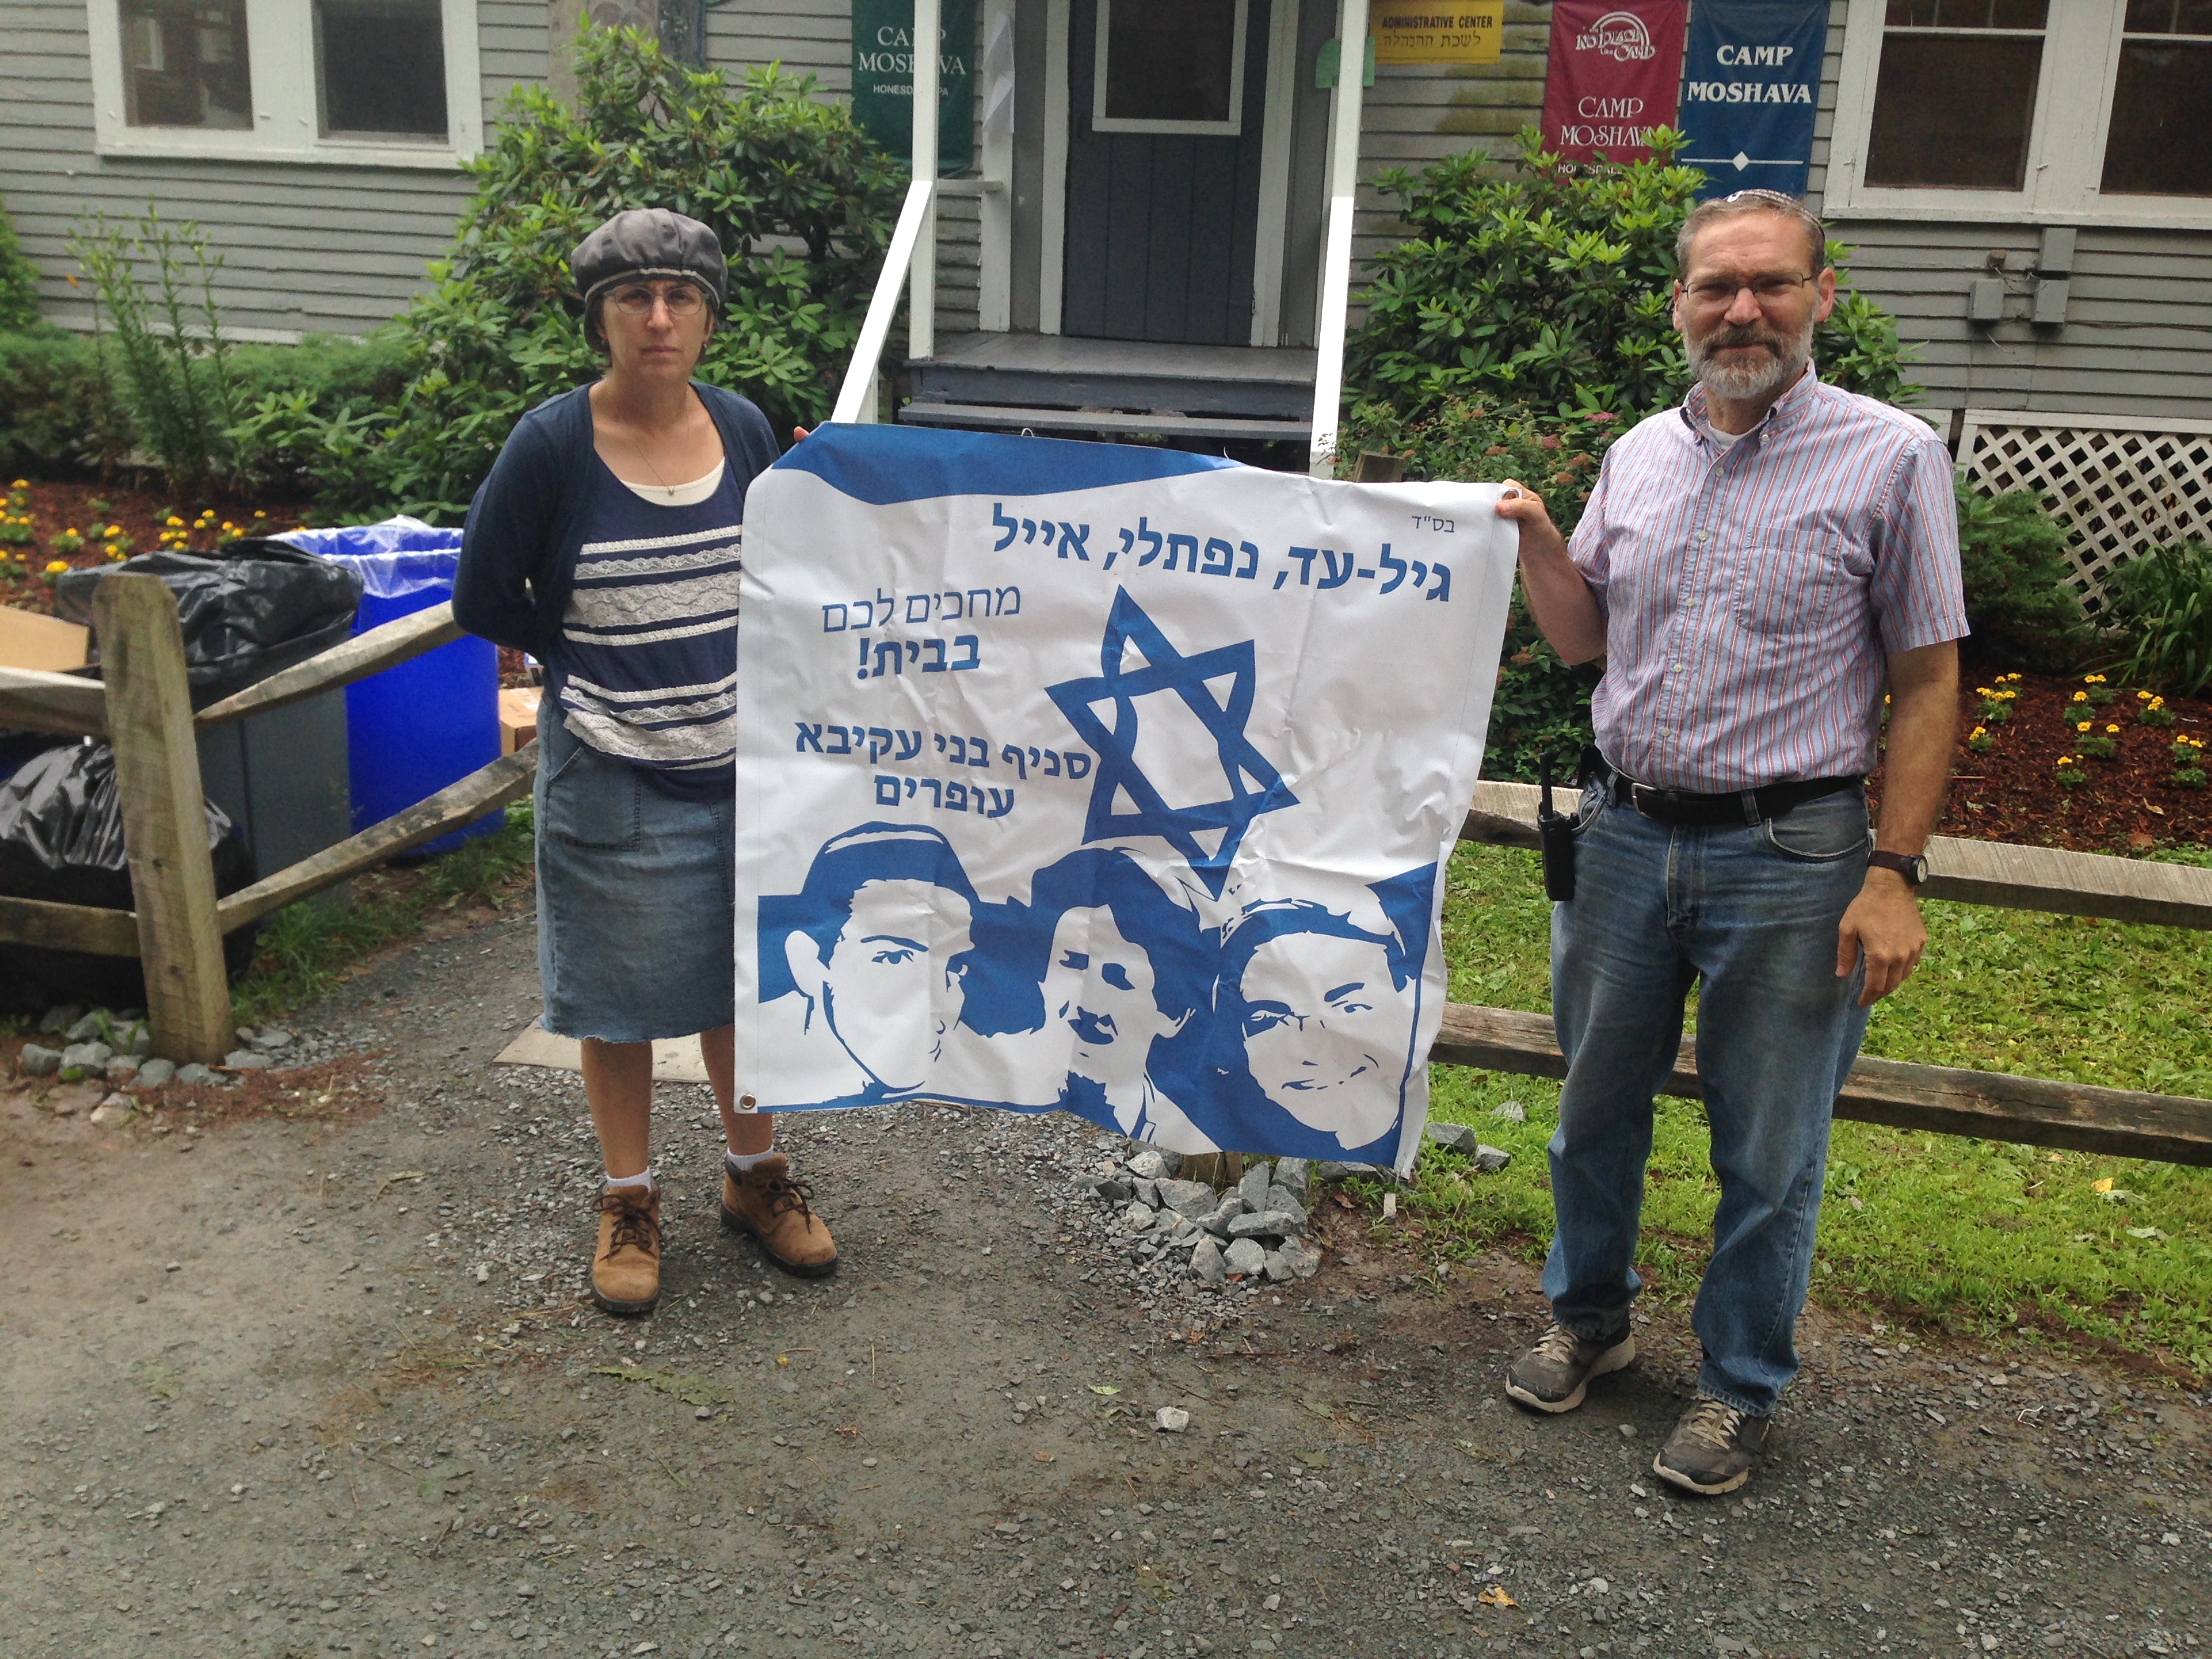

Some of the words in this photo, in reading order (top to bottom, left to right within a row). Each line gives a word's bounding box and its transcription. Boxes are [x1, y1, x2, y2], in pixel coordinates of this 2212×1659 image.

[877, 26, 947, 47] CAP
[1382, 16, 1454, 29] ADMINISTRATIVE
[1458, 16, 1493, 29] CENTER
[1440, 30, 1481, 47] לשכת
[858, 52, 966, 75] MOSVA
[1716, 45, 1794, 66] CAMP
[1578, 96, 1644, 119] CAMP
[1687, 81, 1812, 104] MOSHAVA
[992, 502, 1090, 561] אייל
[1412, 516, 1455, 533] בס"ד
[1102, 516, 1259, 579] נפתלי,
[1272, 543, 1451, 602] גיל-עד,
[822, 588, 895, 633] לכם
[905, 586, 1021, 623] מחכים
[857, 634, 981, 680] בבית!
[794, 722, 922, 765] עקיבא
[933, 733, 990, 768] בני
[1001, 743, 1091, 780] סניף
[874, 775, 1015, 819] עופרים
